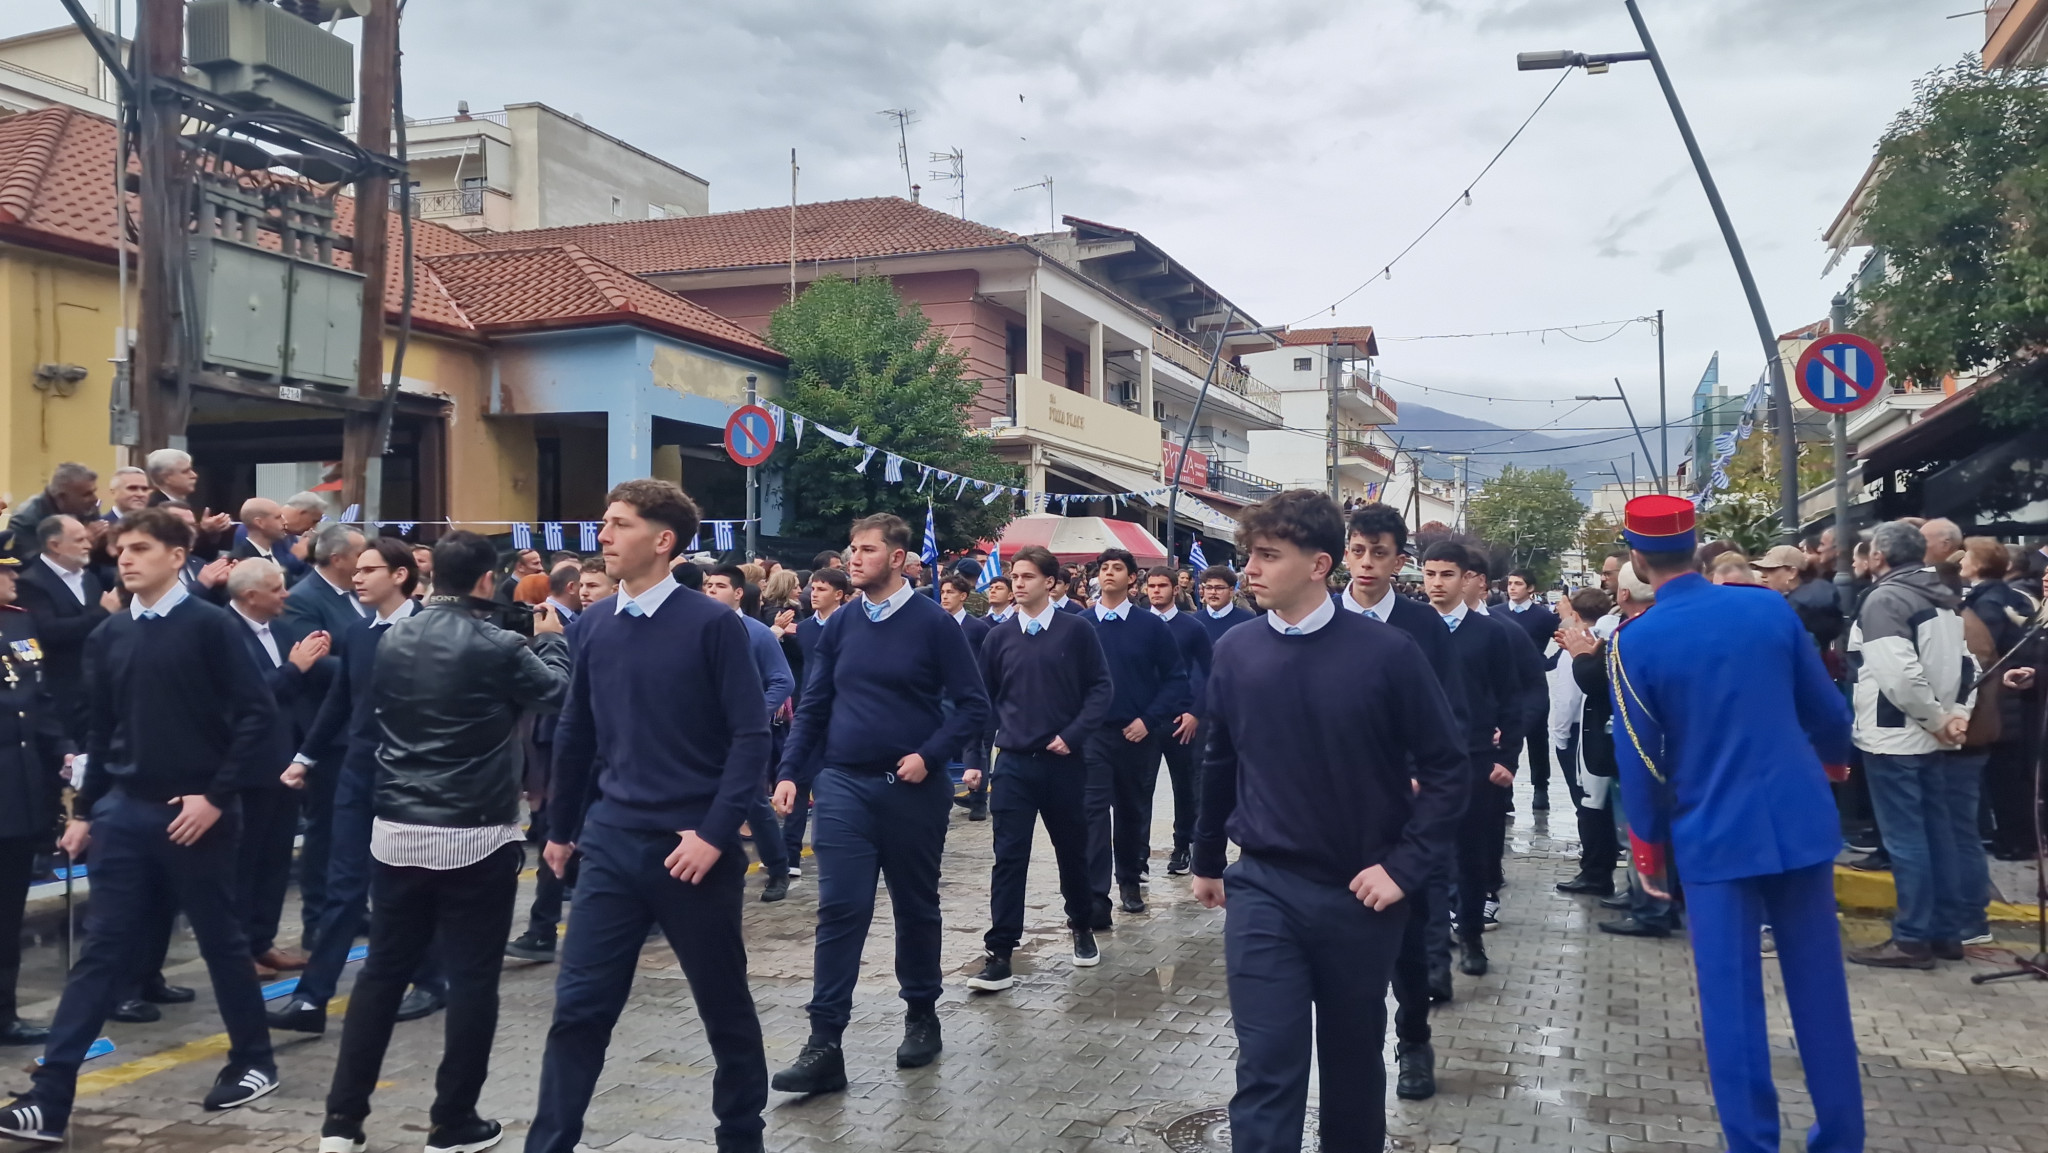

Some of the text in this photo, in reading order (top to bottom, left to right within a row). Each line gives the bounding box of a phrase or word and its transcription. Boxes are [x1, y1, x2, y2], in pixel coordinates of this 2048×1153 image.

[1049, 406, 1085, 430] PIZZA PLACE
[1163, 443, 1195, 475] ΣΥΡΖΑ
